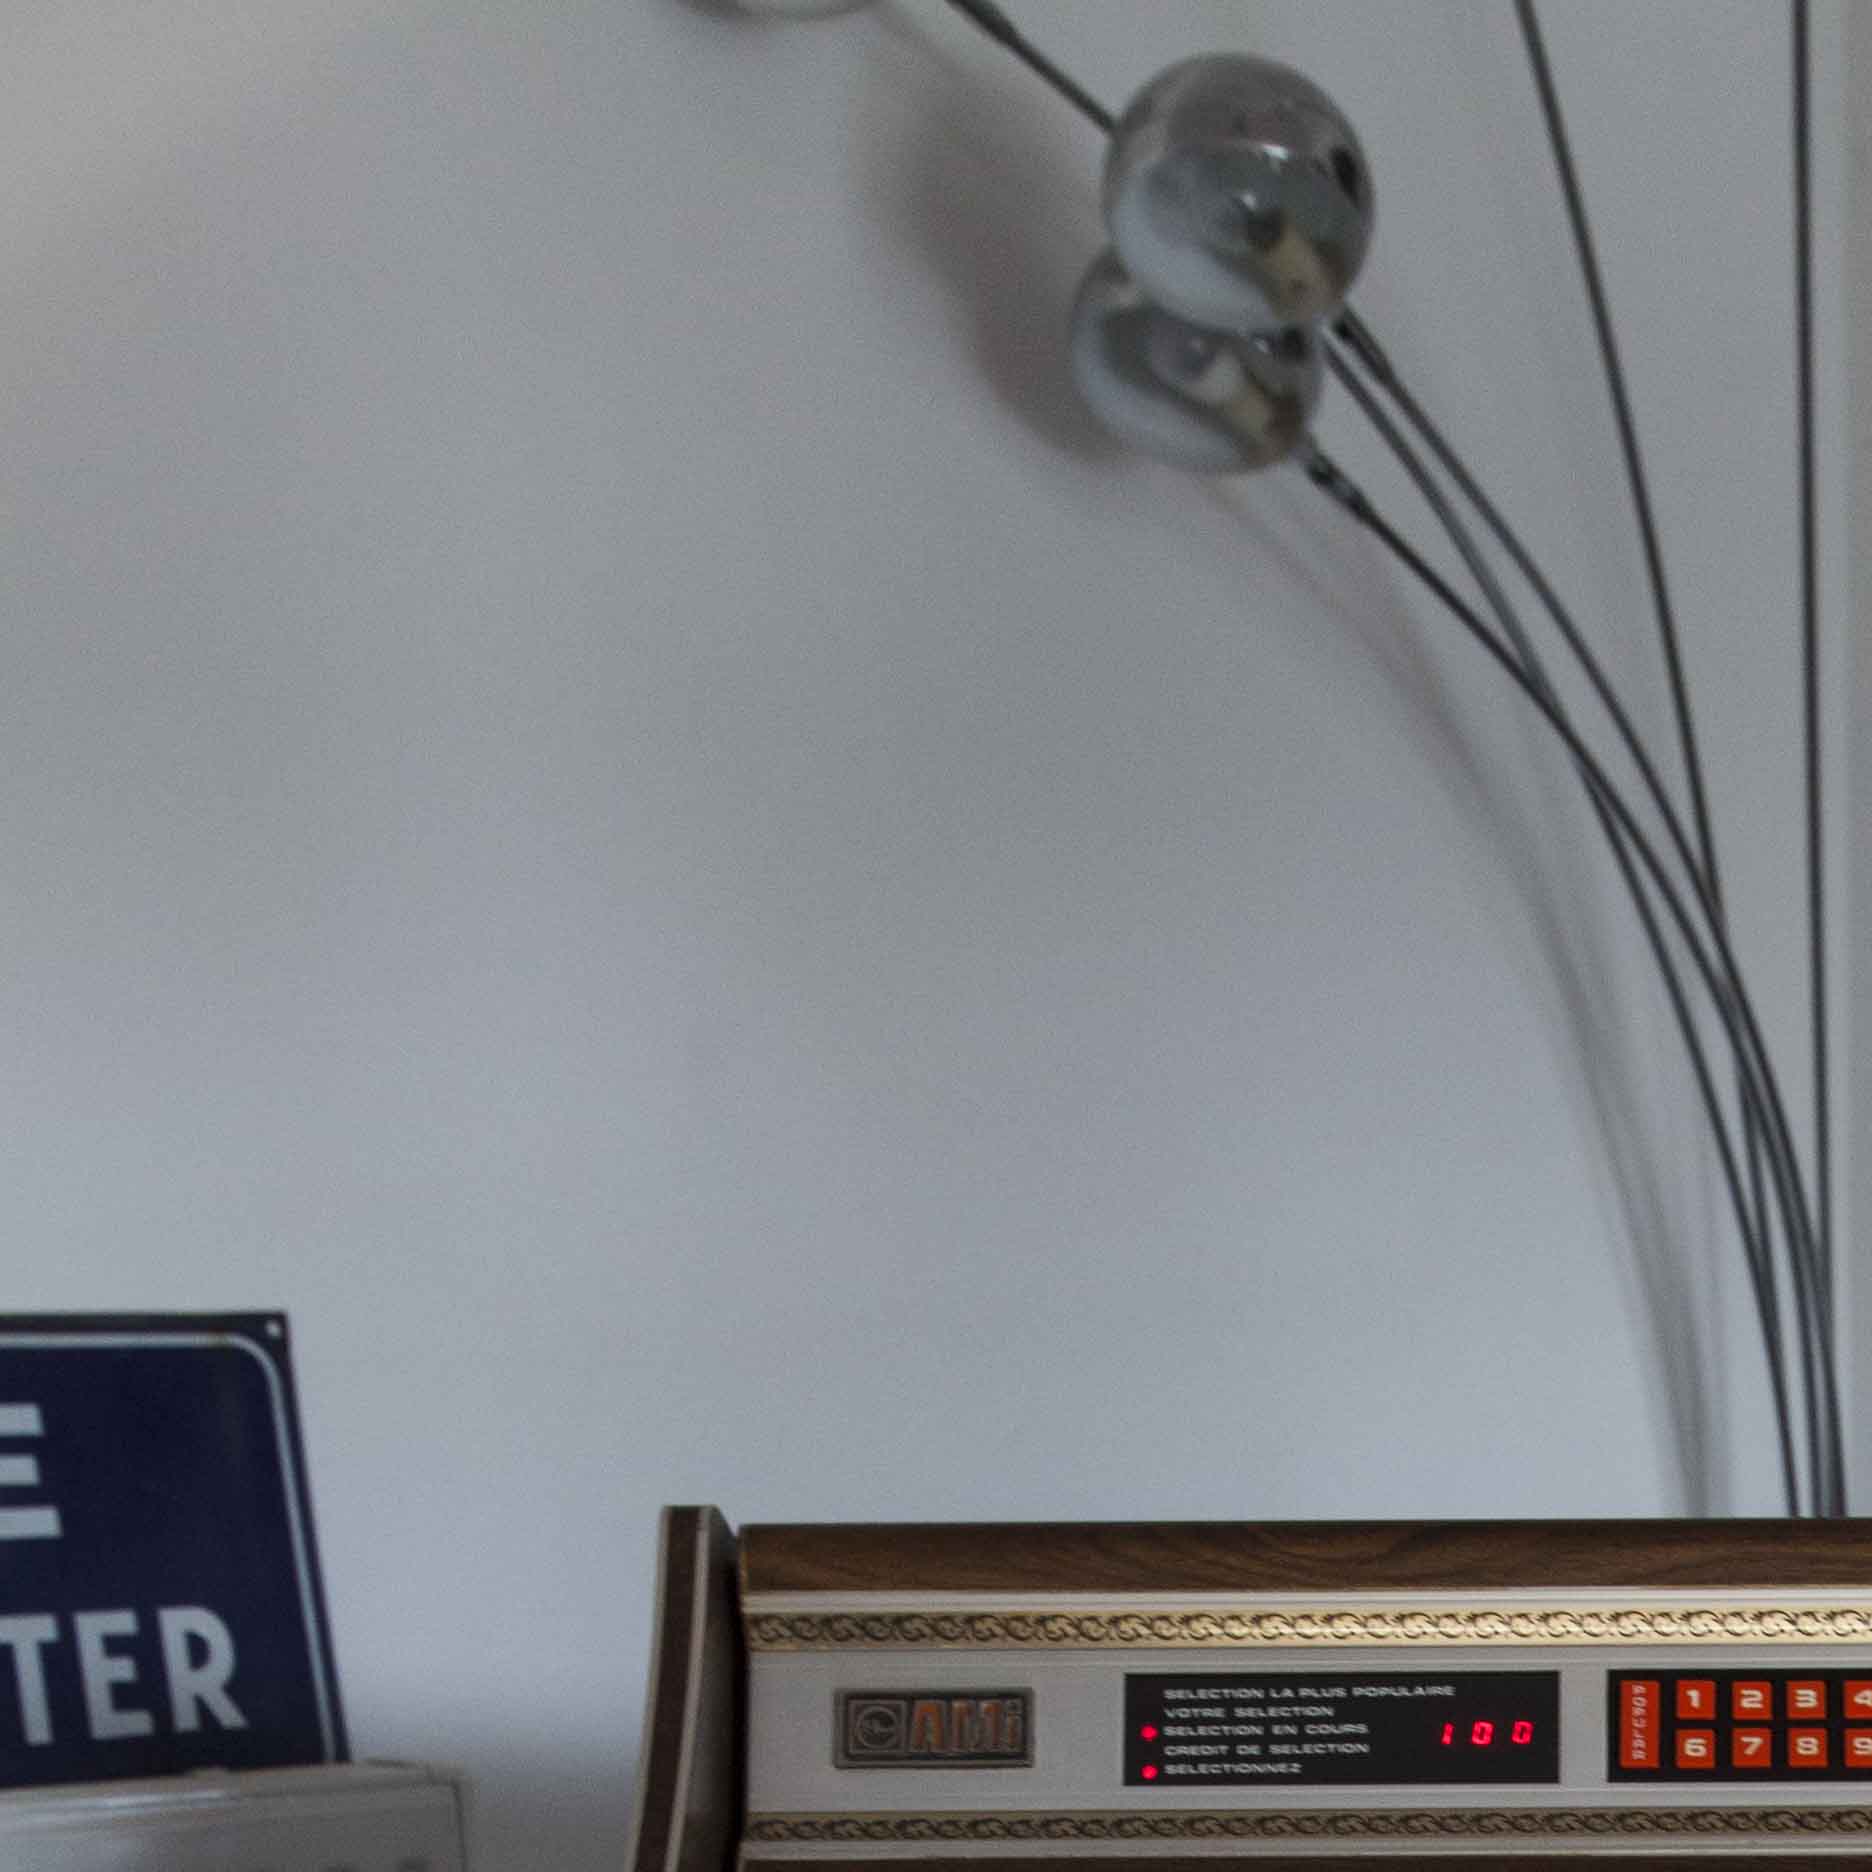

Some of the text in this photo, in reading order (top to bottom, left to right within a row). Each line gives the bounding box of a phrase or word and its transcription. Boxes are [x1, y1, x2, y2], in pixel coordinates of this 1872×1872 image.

[0, 1605, 248, 1746] TER
[1164, 1686, 1456, 1700] SELECTION LA PLUS POPULAIRE
[1686, 1689, 1700, 1708] 1
[1740, 1689, 1764, 1709] 2
[1795, 1689, 1818, 1708] 3
[1164, 1706, 1335, 1718] VOTRE SELECTION
[1163, 1724, 1369, 1736] SELECTION EN COURS
[1631, 1684, 1647, 1760] POPULAR
[1440, 1721, 1534, 1746] 100
[1164, 1743, 1370, 1756] CREDIT DE SELECTION
[1683, 1738, 1707, 1757] 6
[1740, 1737, 1763, 1755] 7
[1795, 1737, 1819, 1756] 8
[1164, 1763, 1302, 1775] SELECTIONNEZ
